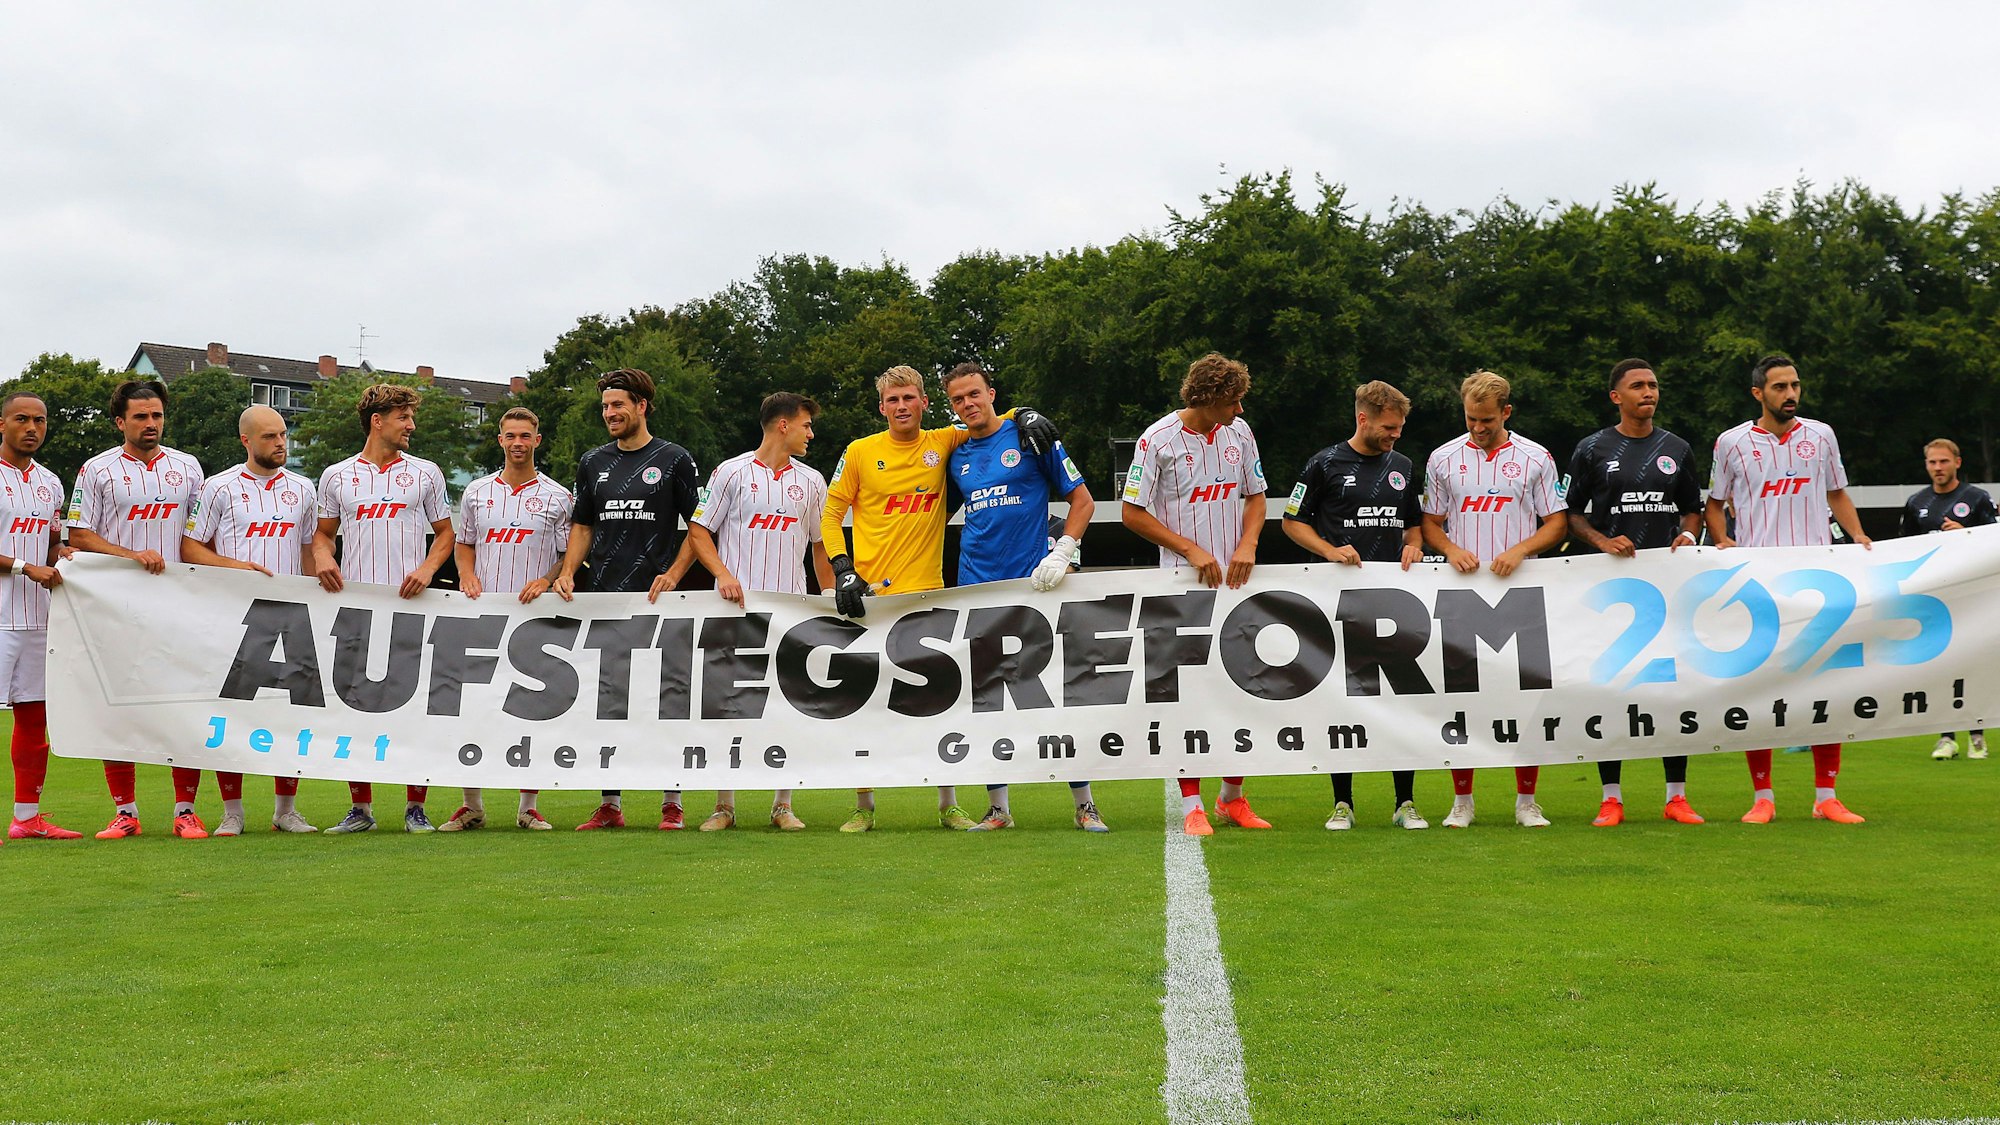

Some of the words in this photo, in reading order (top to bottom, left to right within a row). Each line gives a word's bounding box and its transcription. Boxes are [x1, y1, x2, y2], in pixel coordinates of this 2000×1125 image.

[971, 484, 1008, 501] evo
[1190, 482, 1237, 503] HIT
[1760, 477, 1811, 498] HIT
[605, 500, 645, 510] evo
[883, 492, 939, 515] HIT
[989, 498, 998, 508] ES
[999, 495, 1023, 506] ZÄHLT.
[1460, 495, 1514, 513] HIT
[1620, 491, 1665, 502] evo
[127, 503, 178, 520] HIT
[356, 502, 406, 521] HIT
[625, 511, 633, 520] ES
[1357, 506, 1398, 517] evo
[1621, 504, 1644, 512] WENN
[1645, 503, 1653, 512] ES
[9, 518, 48, 534] HIT
[246, 521, 295, 538] HIT
[749, 514, 798, 532] HIT
[1343, 519, 1357, 529] DA,
[1357, 518, 1379, 528] WENN
[1379, 518, 1389, 527] ES
[486, 528, 534, 543] HIT
[1422, 555, 1445, 563] evo
[218, 586, 1553, 721] AUFSTIEGSREFORM
[1584, 546, 1953, 690] 2025
[204, 716, 391, 762] Jetzt
[458, 735, 617, 769] oder
[682, 735, 787, 769] nie
[937, 721, 1369, 764] Gemeinsam
[1441, 678, 1965, 745] durchsetzen!
